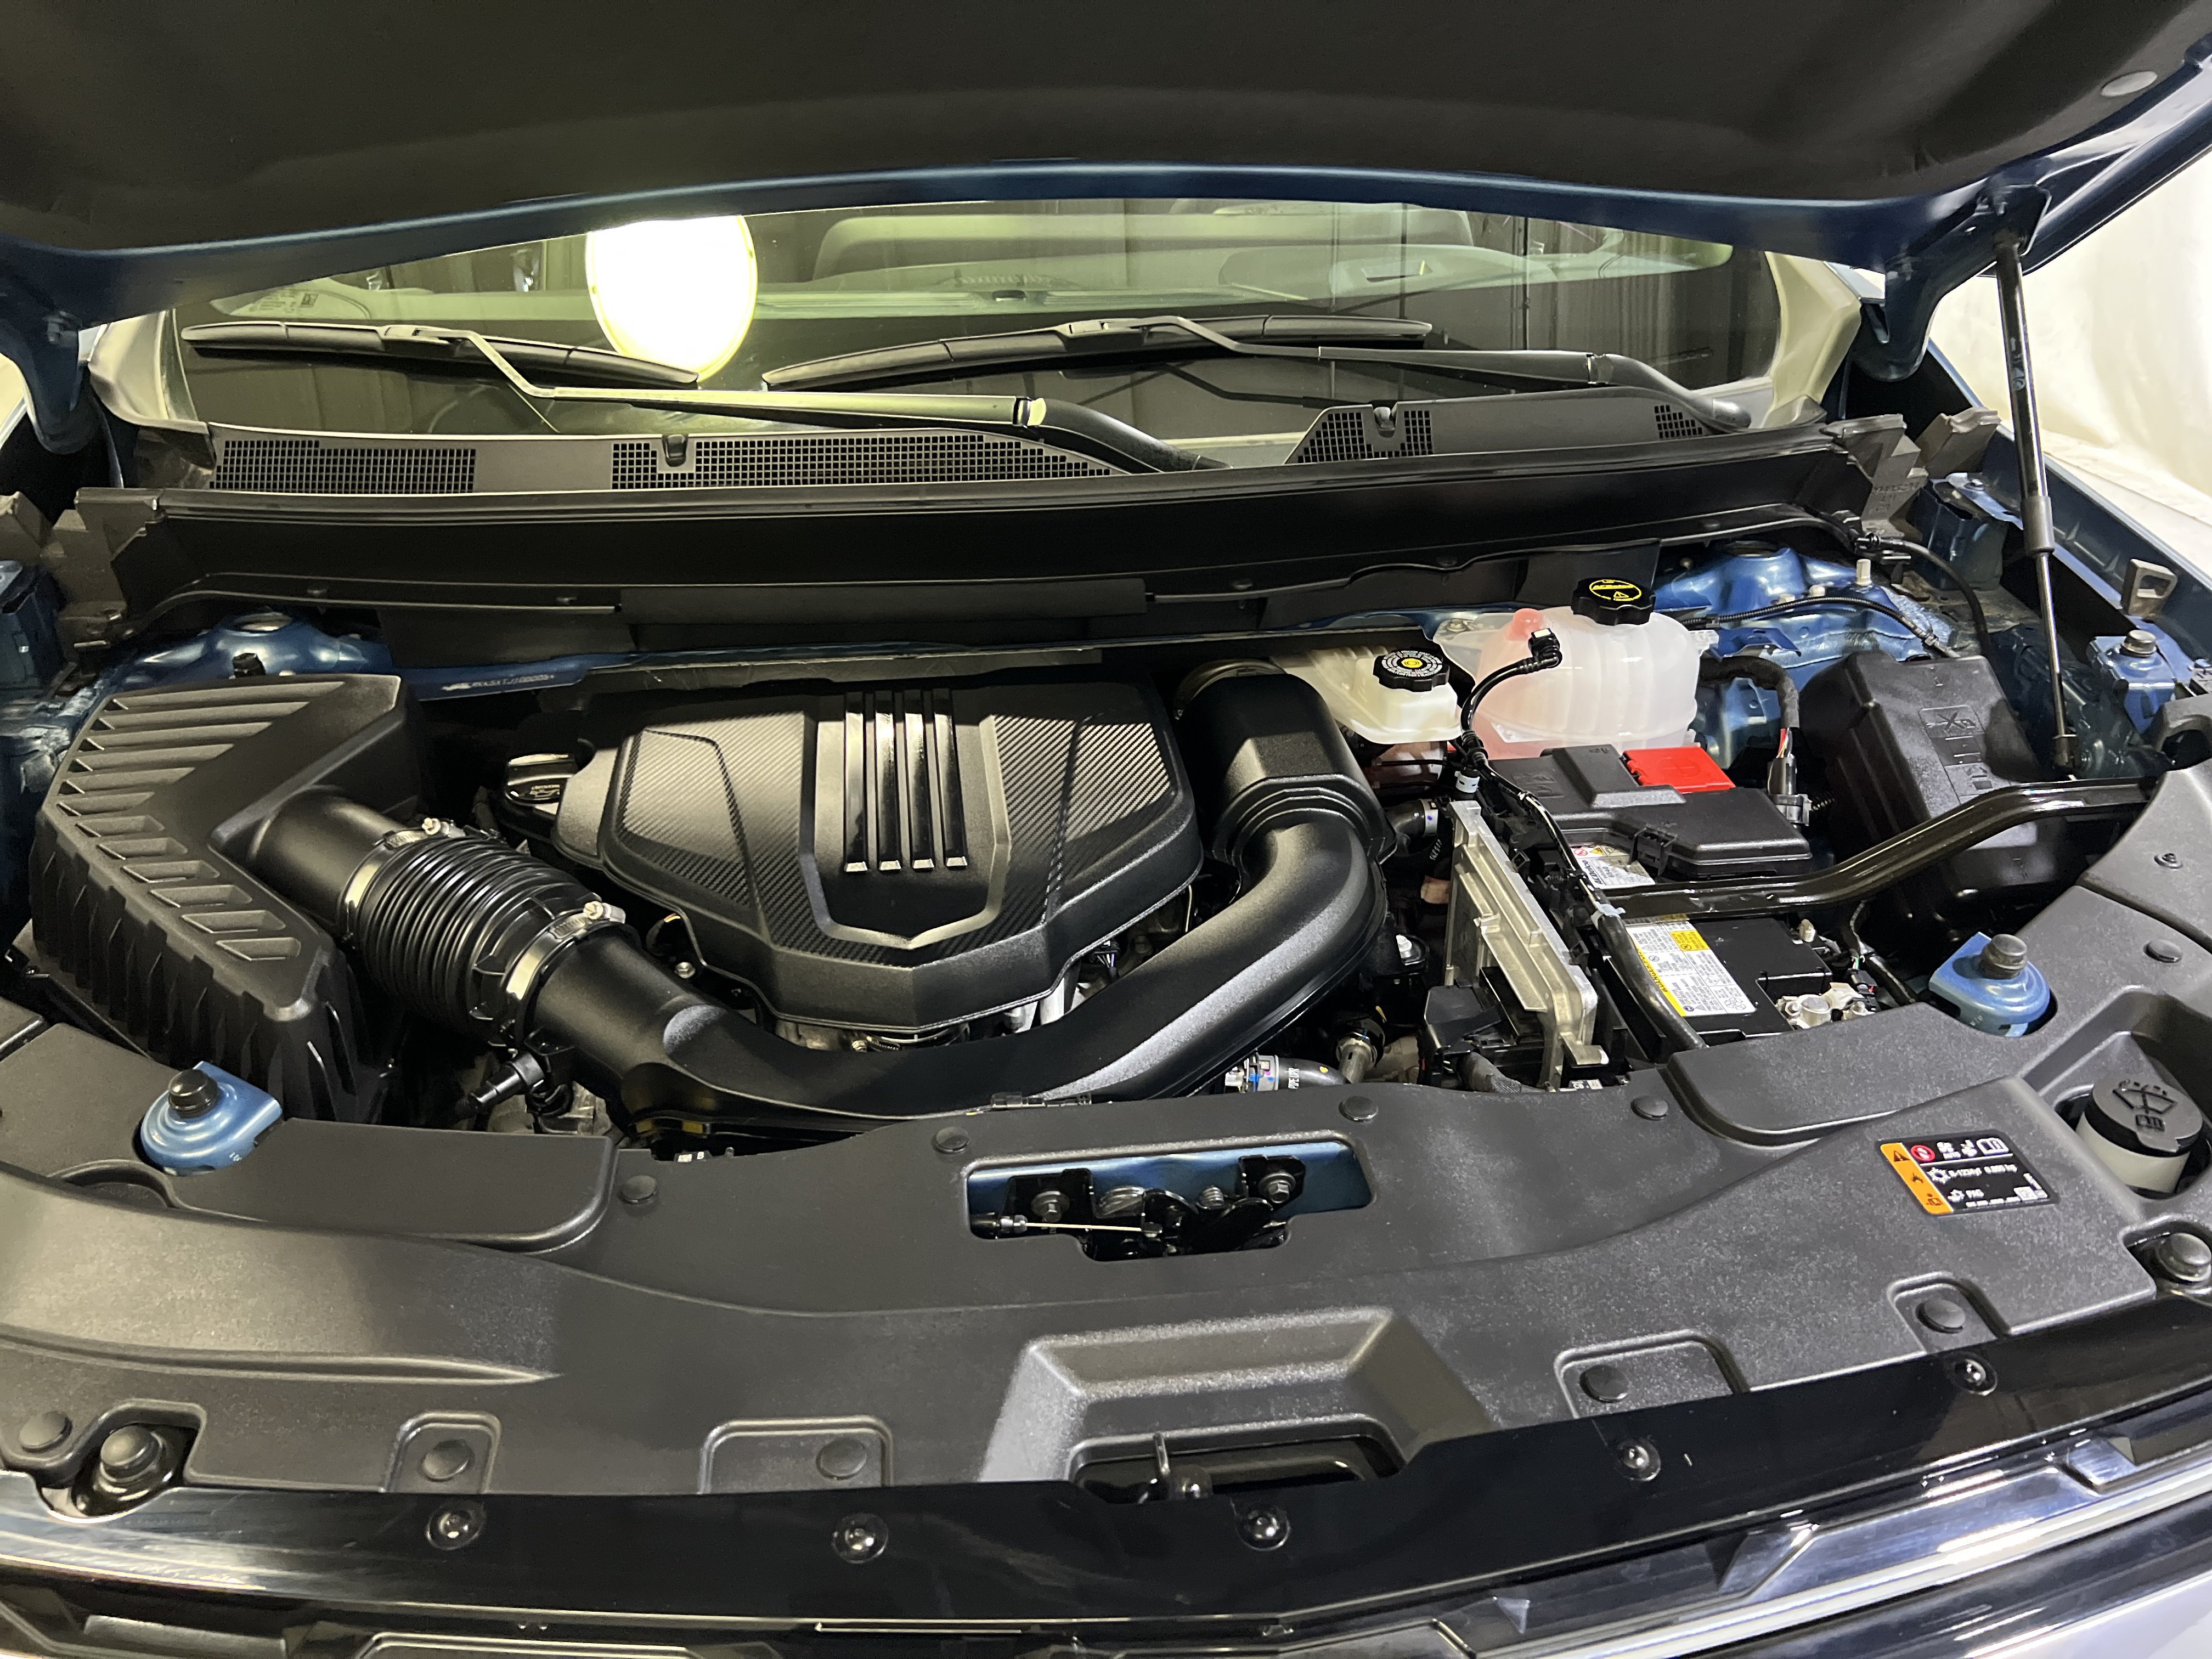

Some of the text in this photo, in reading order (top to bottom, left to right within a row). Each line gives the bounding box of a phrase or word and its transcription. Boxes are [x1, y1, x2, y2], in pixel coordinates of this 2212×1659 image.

[1582, 860, 1603, 884] ACDelco
[1288, 1077, 1300, 1089] PIPE
[1943, 1152, 1961, 1160] AUTO
